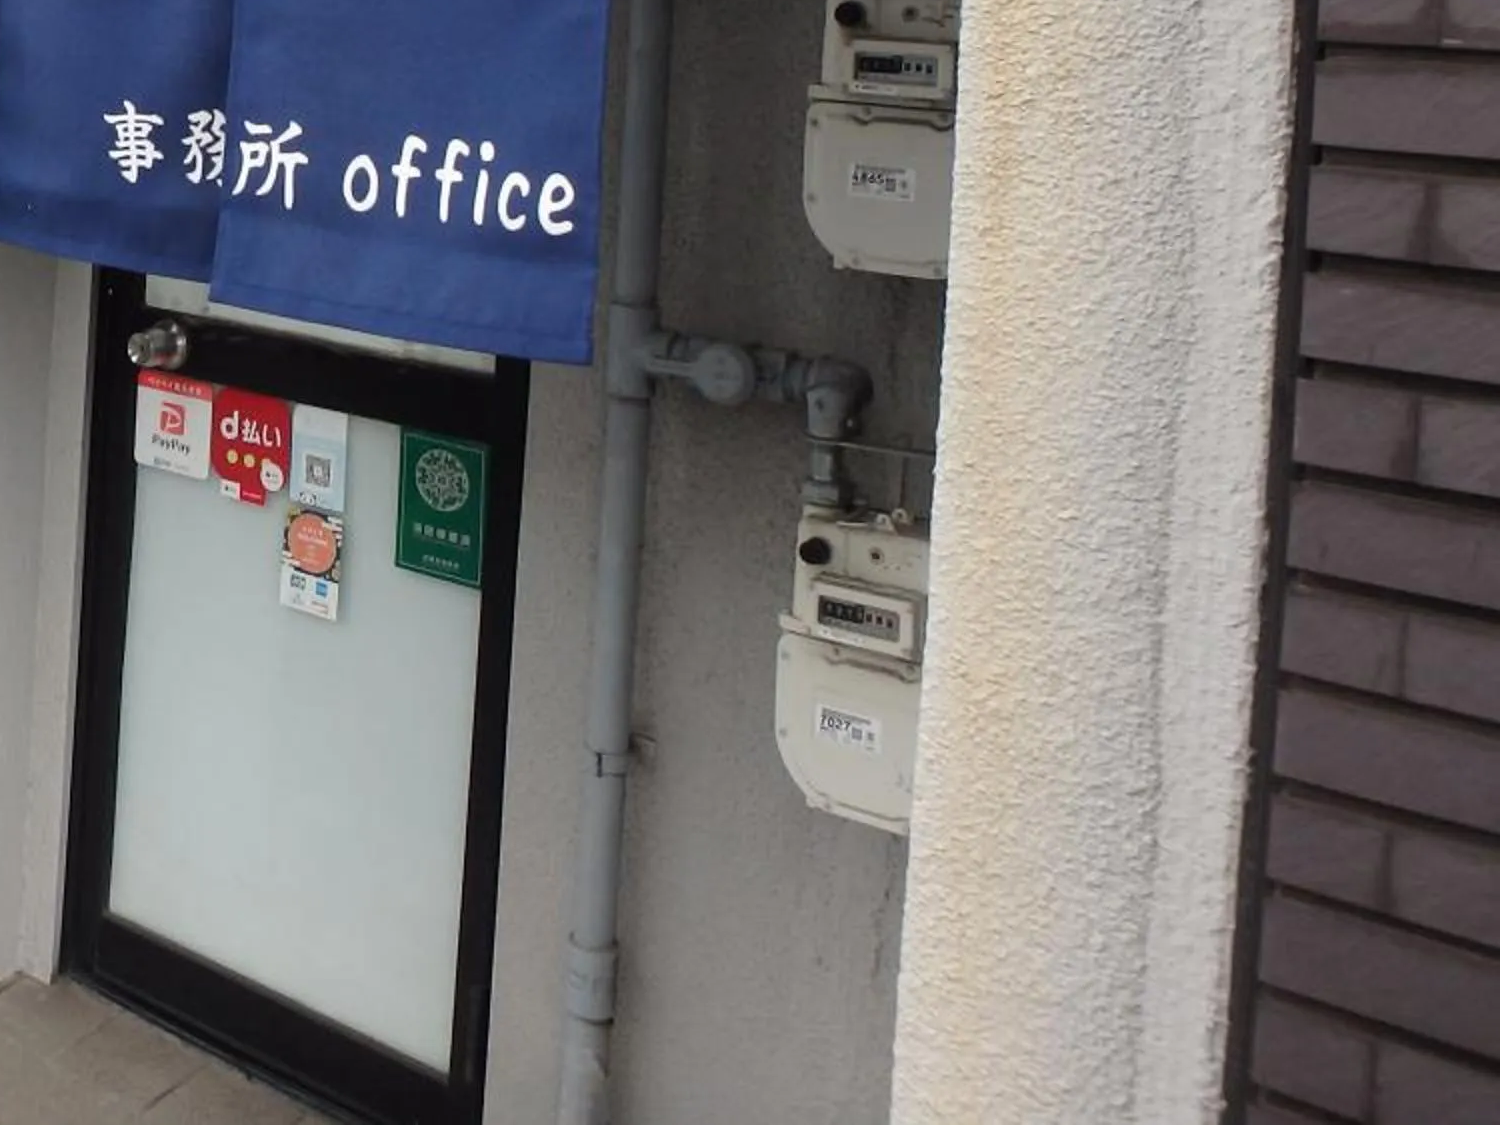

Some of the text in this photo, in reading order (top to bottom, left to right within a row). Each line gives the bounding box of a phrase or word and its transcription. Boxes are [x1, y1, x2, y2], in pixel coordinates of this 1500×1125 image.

[103, 101, 576, 236] 事務所 office
[219, 410, 281, 448] d払い
